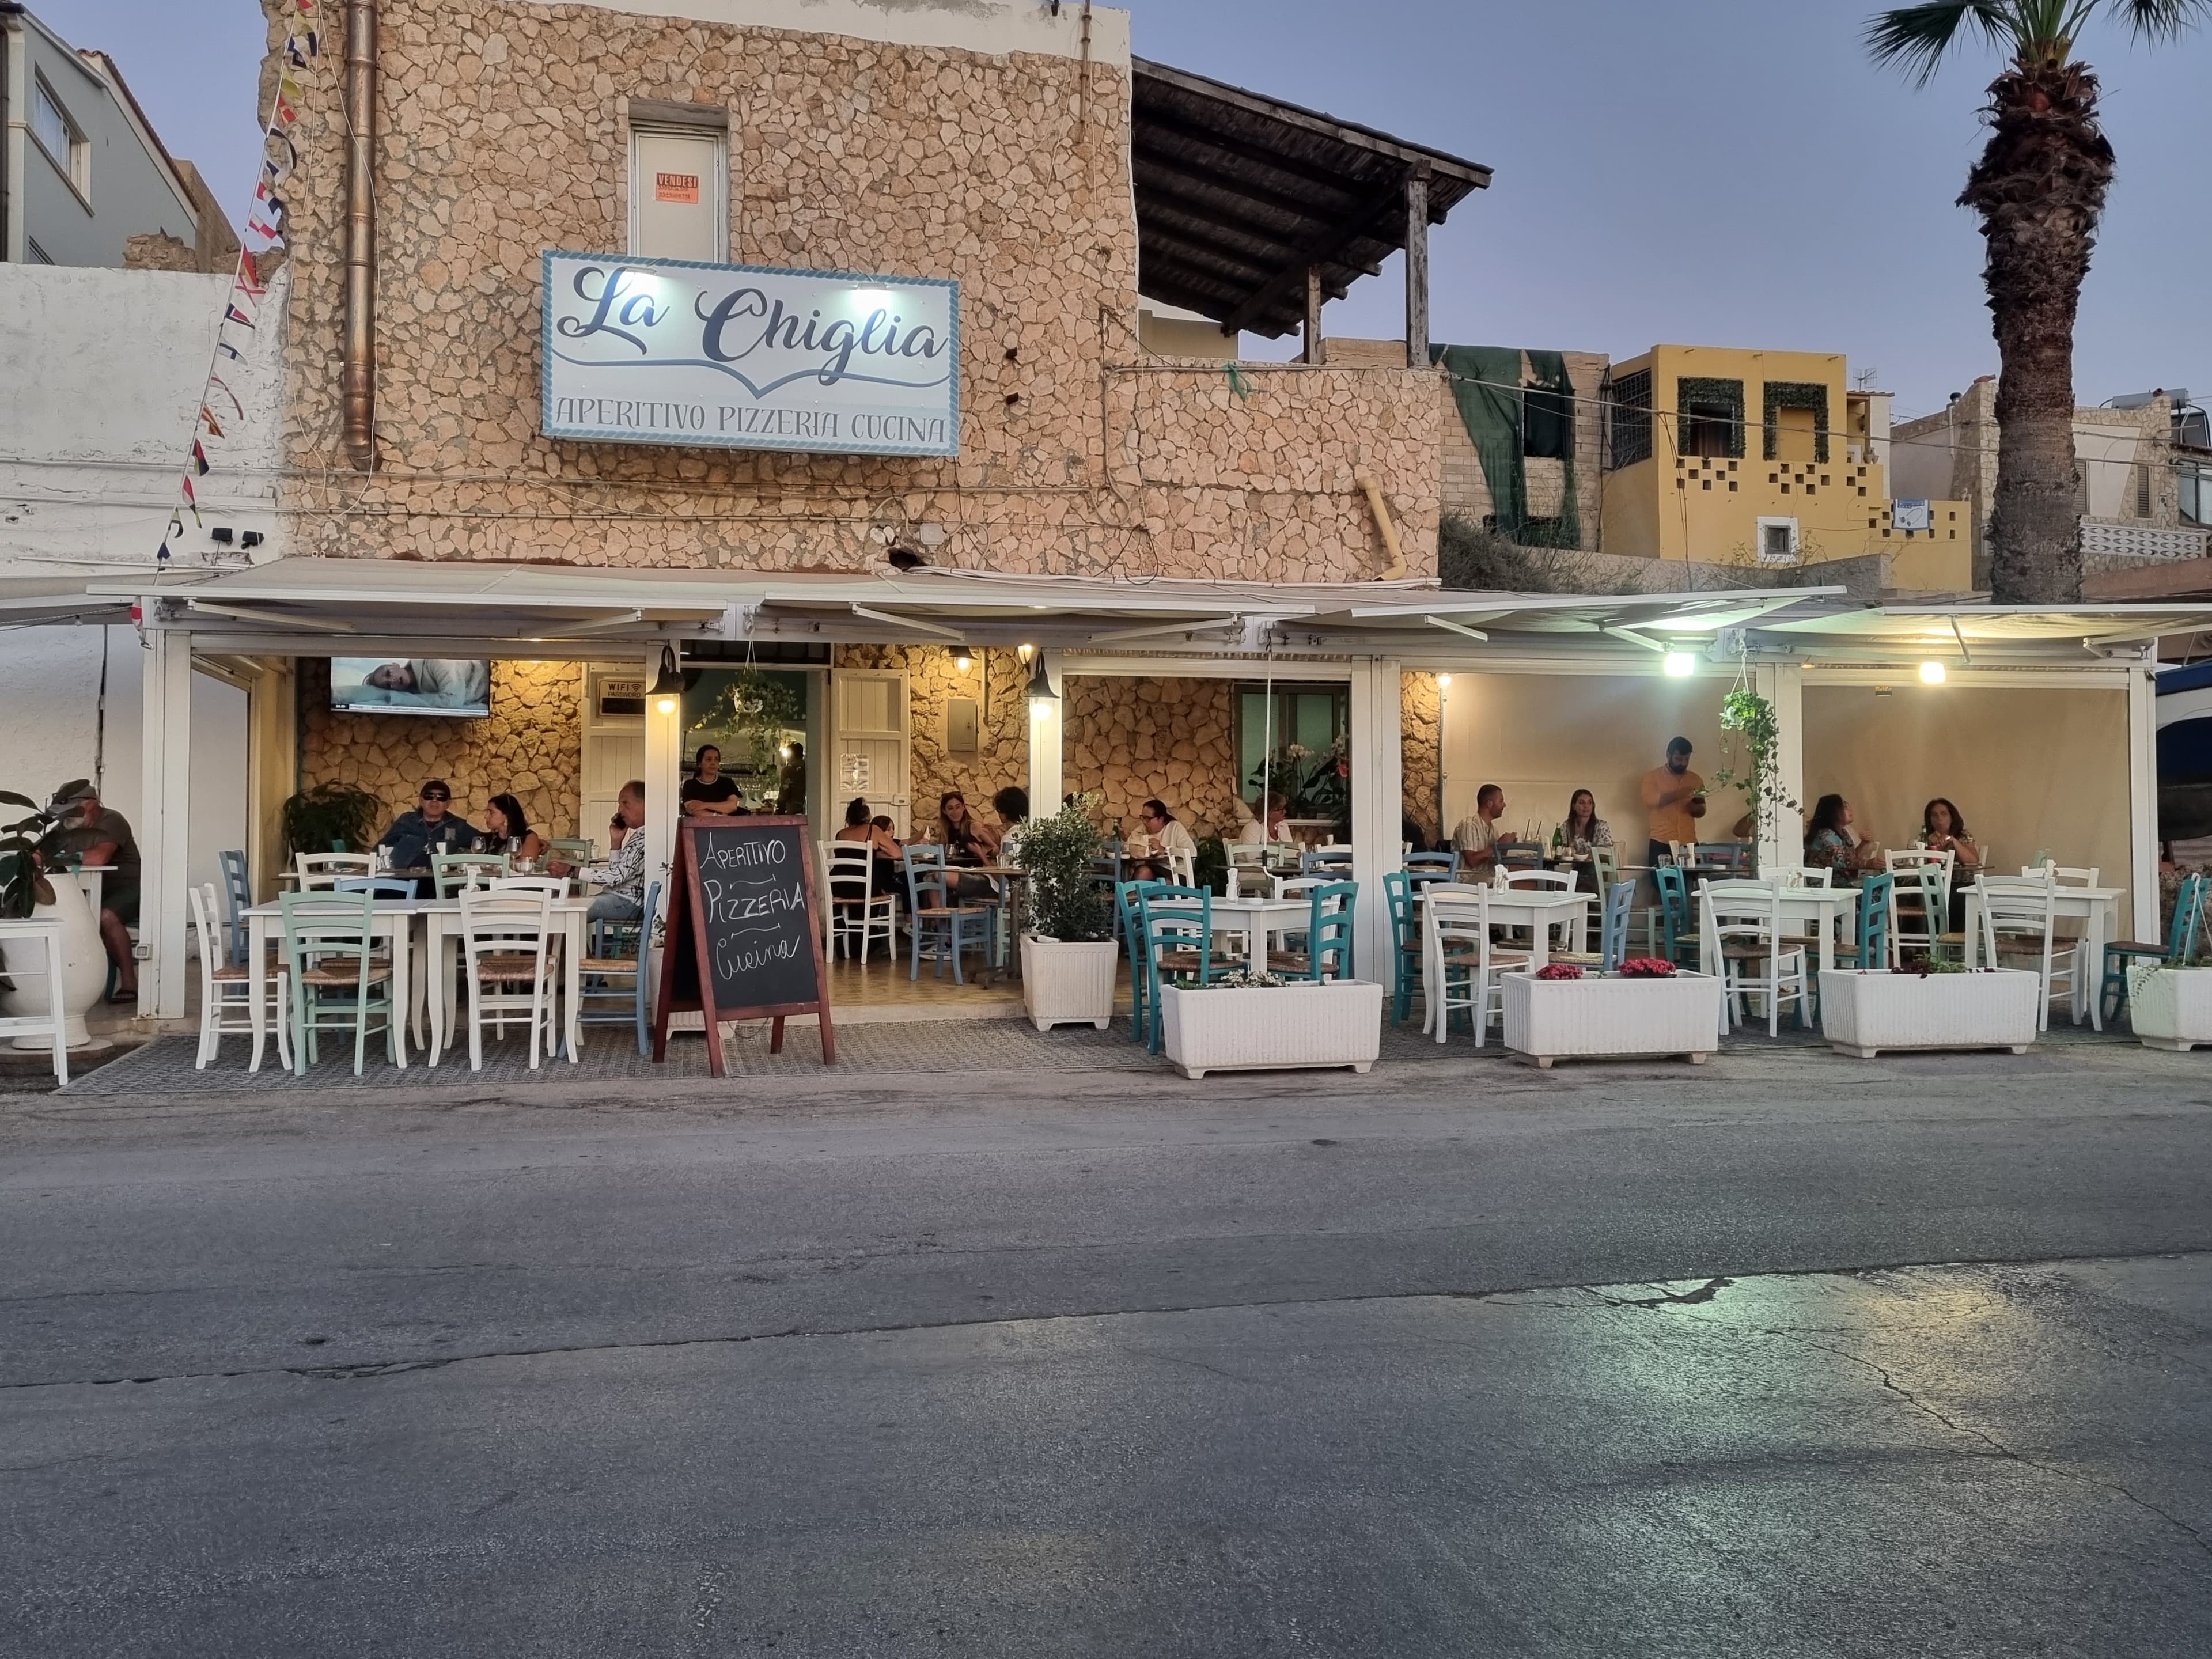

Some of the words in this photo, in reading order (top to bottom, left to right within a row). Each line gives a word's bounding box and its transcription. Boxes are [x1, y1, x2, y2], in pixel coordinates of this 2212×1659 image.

[658, 175, 697, 188] VENDESI
[556, 266, 670, 355] La
[694, 287, 949, 387] Chiglia
[555, 397, 705, 430] APERITIVO
[718, 406, 840, 438] PIZZERIA
[851, 414, 946, 443] CUCINA
[703, 879, 806, 923] PIZZERIA
[716, 935, 801, 980] Cucina
